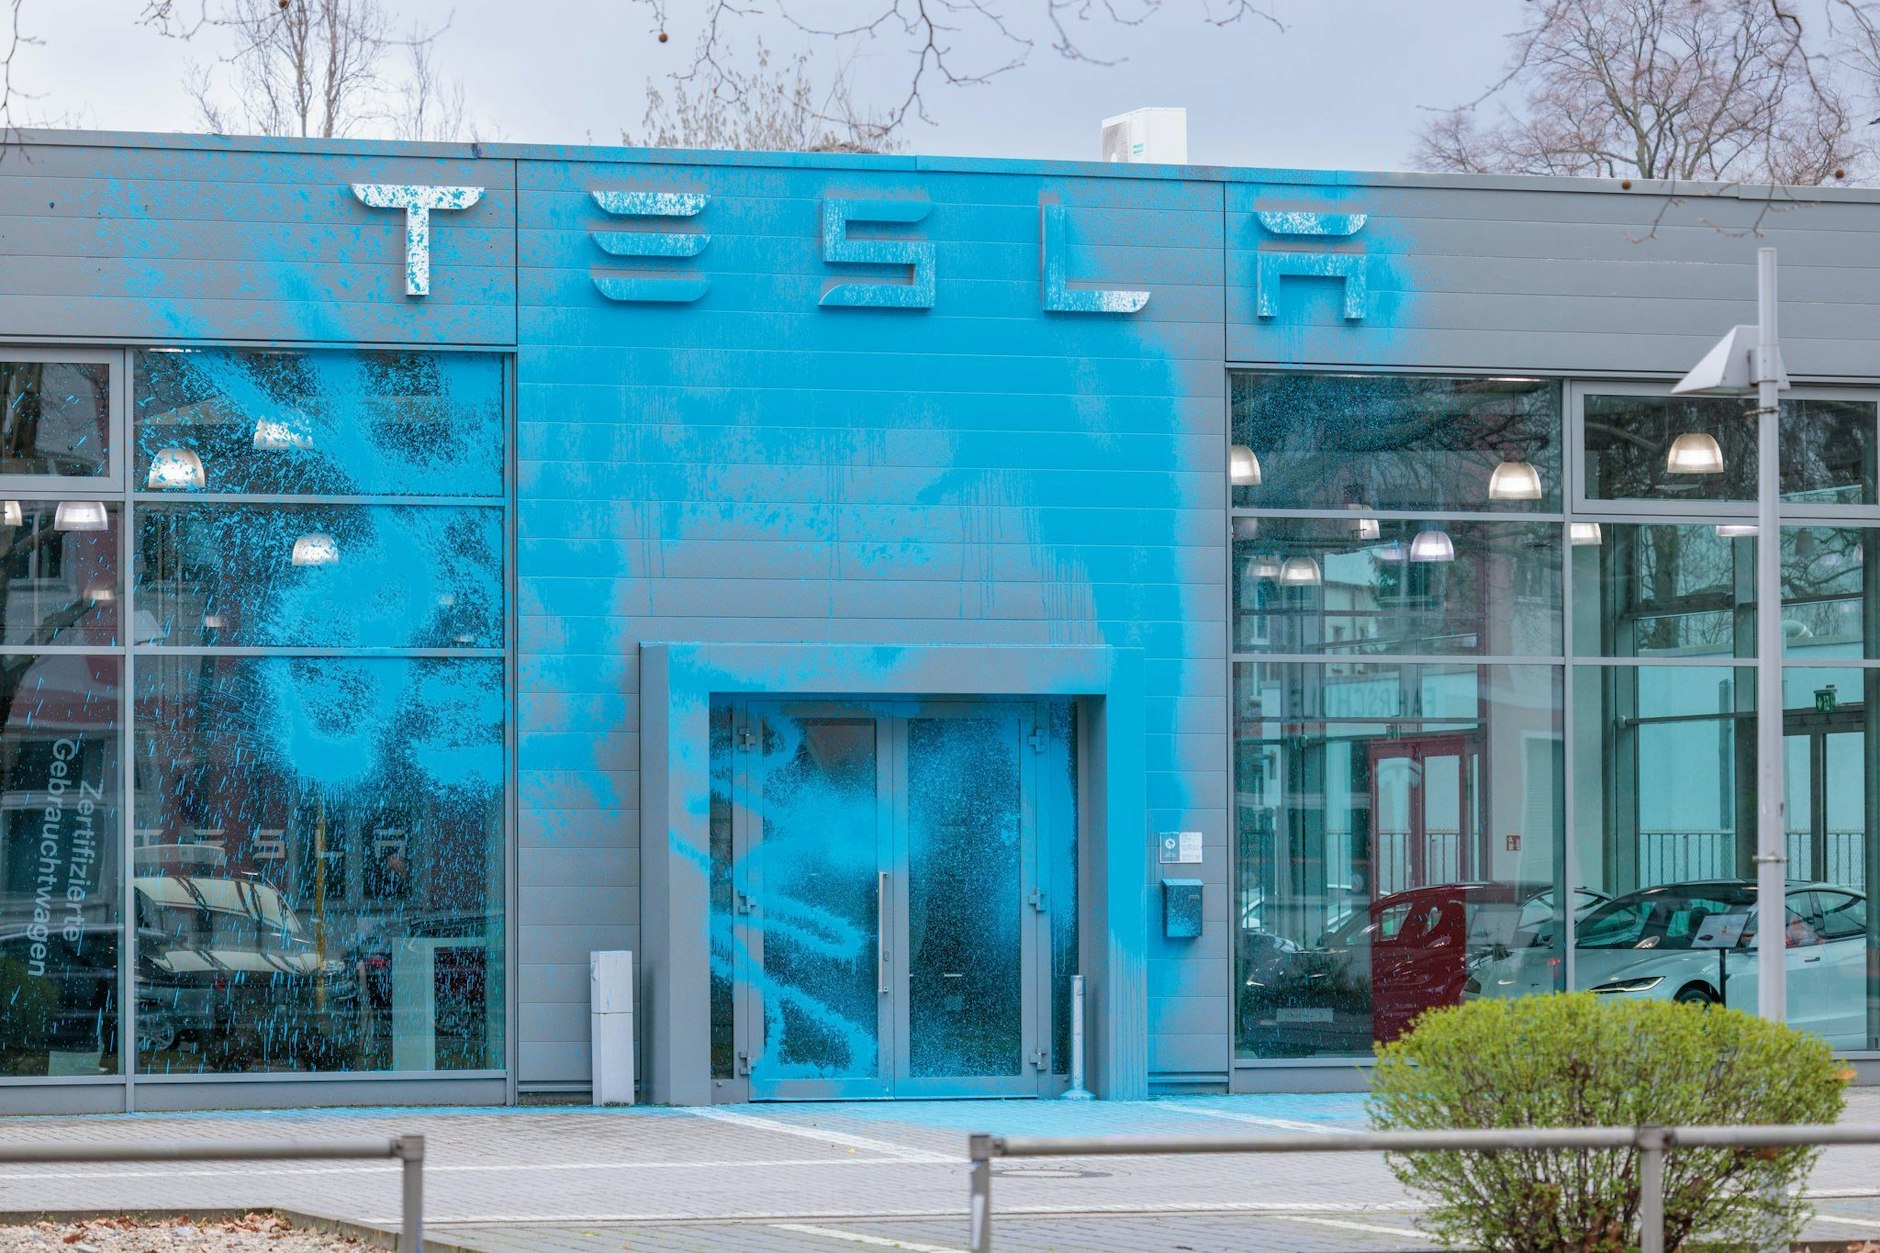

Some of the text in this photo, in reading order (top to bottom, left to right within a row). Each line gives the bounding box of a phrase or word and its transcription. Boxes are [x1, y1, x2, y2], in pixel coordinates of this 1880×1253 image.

[350, 183, 1368, 320] TESLA
[26, 738, 76, 976] Gebrauchtwagen
[62, 779, 103, 942] Zertifizierte
